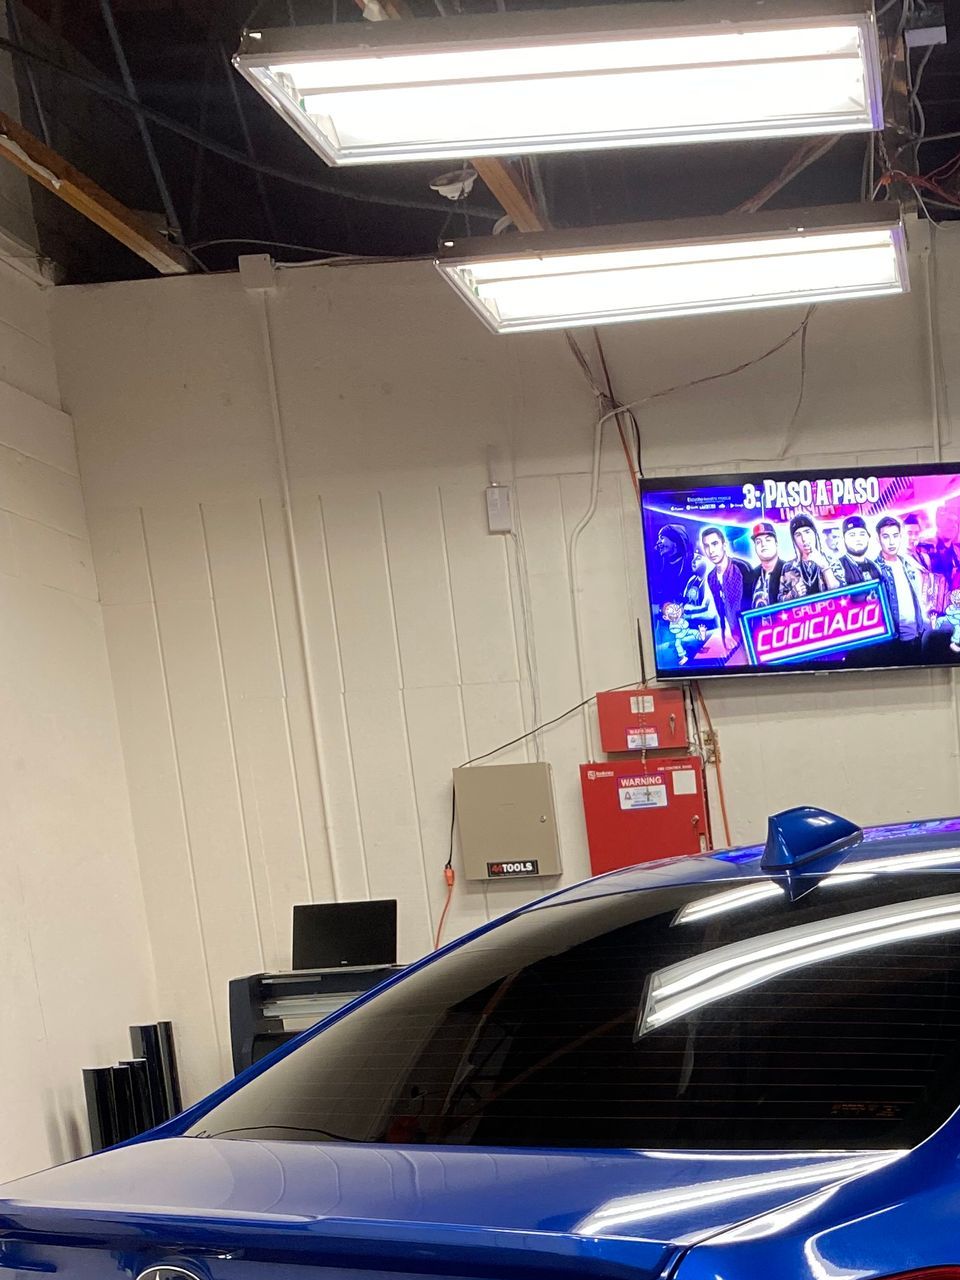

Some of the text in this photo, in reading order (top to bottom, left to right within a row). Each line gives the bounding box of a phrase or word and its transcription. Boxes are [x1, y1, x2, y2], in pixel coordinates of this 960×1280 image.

[743, 477, 880, 509] 3: PASO A PASO
[792, 600, 835, 619] GRUPO
[757, 604, 880, 651] CODICIADO
[620, 776, 662, 787] WARNING
